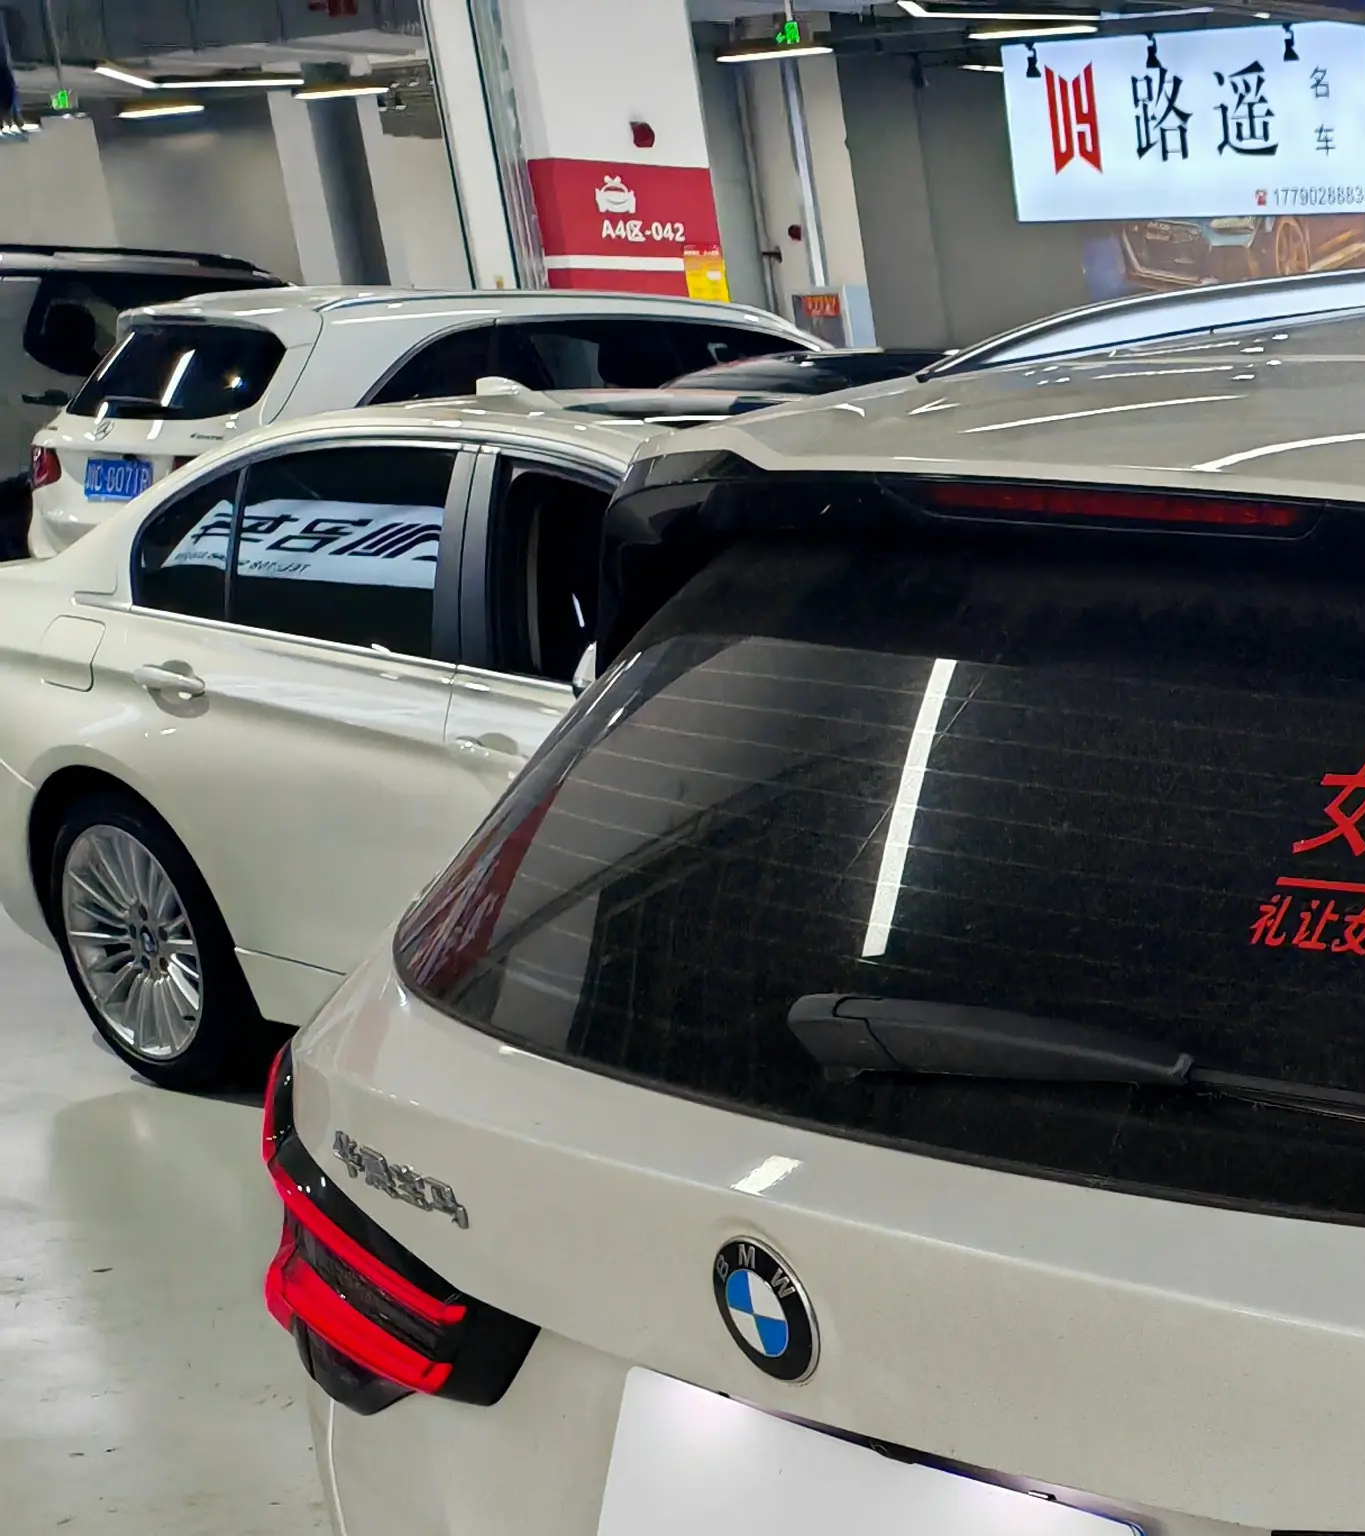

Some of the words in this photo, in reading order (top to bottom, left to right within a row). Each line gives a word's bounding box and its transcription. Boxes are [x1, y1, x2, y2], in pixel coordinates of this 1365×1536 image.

[1130, 60, 1280, 162] 路遥
[1309, 65, 1337, 156] 名车
[716, 1243, 796, 1299] BMW
